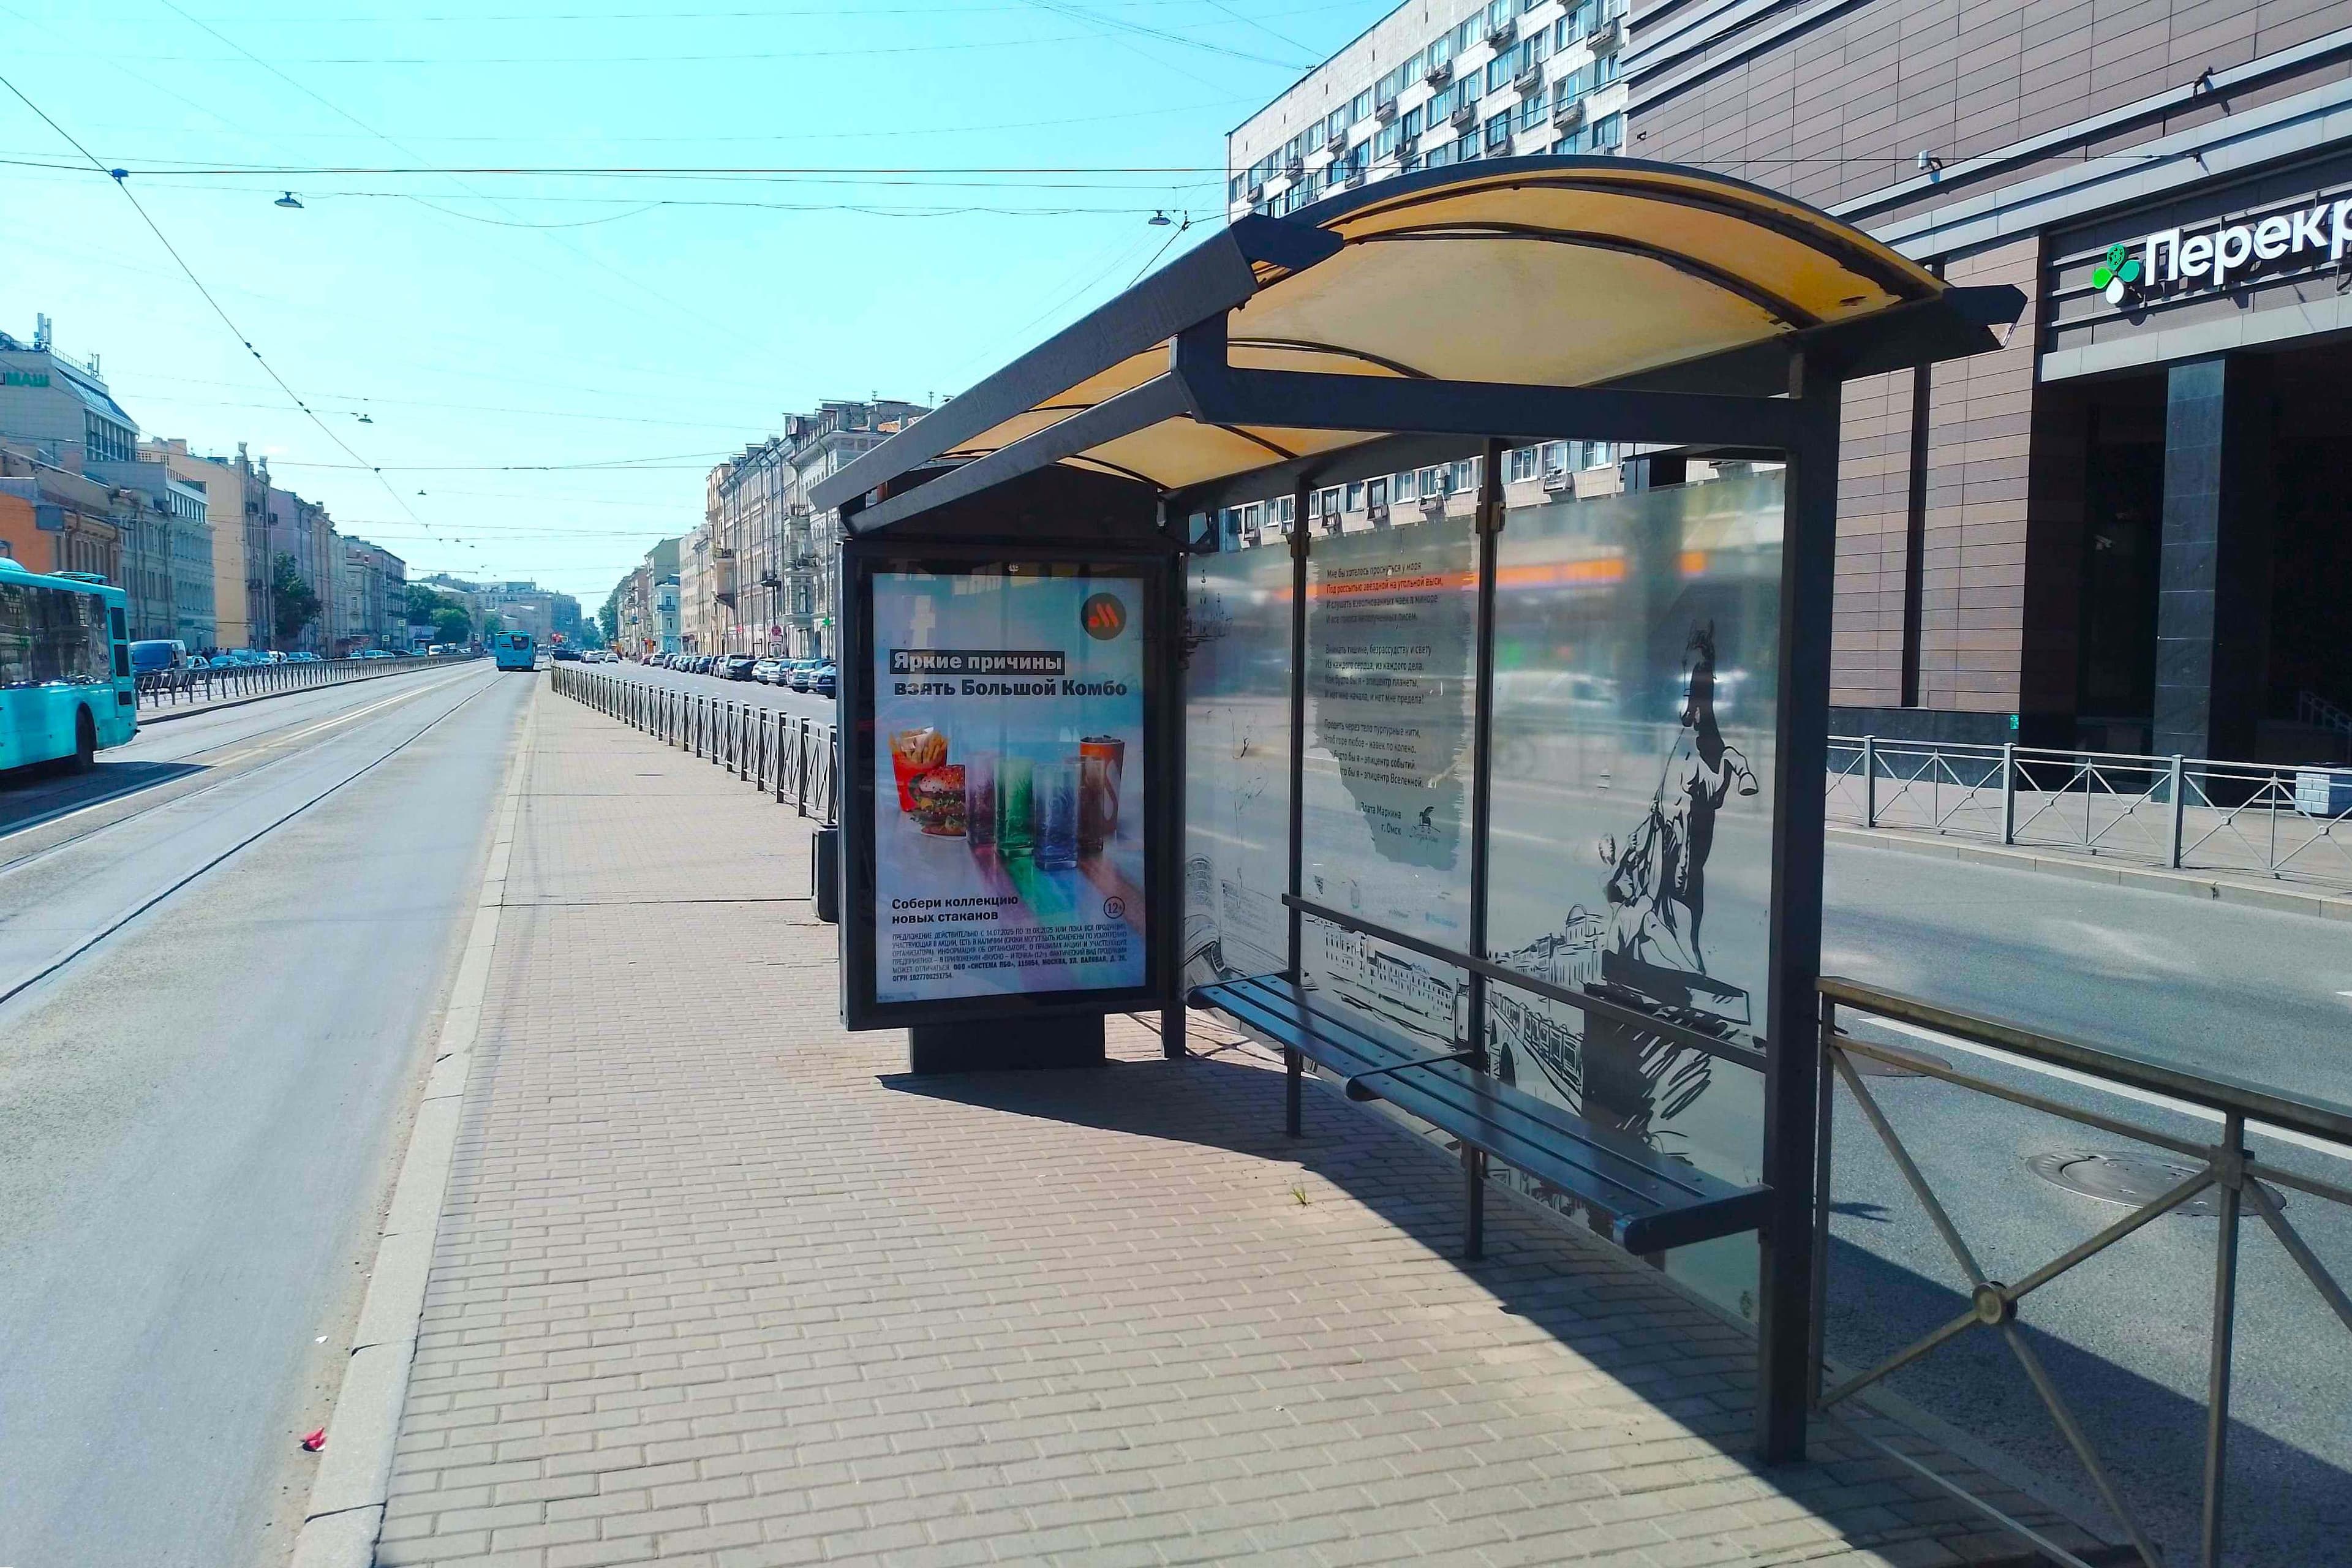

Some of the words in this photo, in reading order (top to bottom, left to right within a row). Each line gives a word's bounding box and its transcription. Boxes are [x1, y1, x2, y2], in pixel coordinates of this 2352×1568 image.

[1327, 584, 1336, 594] Под
[1397, 576, 1424, 590] угольной
[1370, 644, 1409, 656] безрассудству
[1415, 646, 1431, 657] свету
[894, 652, 962, 672] Яркие
[968, 656, 1062, 673] причины
[1384, 662, 1407, 671] каждого
[894, 682, 956, 696] взять
[962, 679, 1056, 696] Большой
[1062, 680, 1128, 696] Комбо
[1397, 694, 1424, 706] предела!
[1374, 725, 1403, 737] пурпурные
[1386, 742, 1393, 751] по
[1364, 772, 1389, 785] эпицентр
[1377, 804, 1401, 820] Маркина
[1387, 823, 1401, 835] Омск
[892, 898, 941, 910] Собери
[945, 896, 1018, 908] коллекцию
[892, 914, 934, 924] новых
[938, 911, 998, 922] стаканов
[934, 930, 979, 940] ДЕЙСТВИТЕЛЬНО
[892, 940, 932, 949] УЧАСТВУЮЩАЯ
[892, 957, 932, 965] ПРЕДПРИЯТИЯХ
